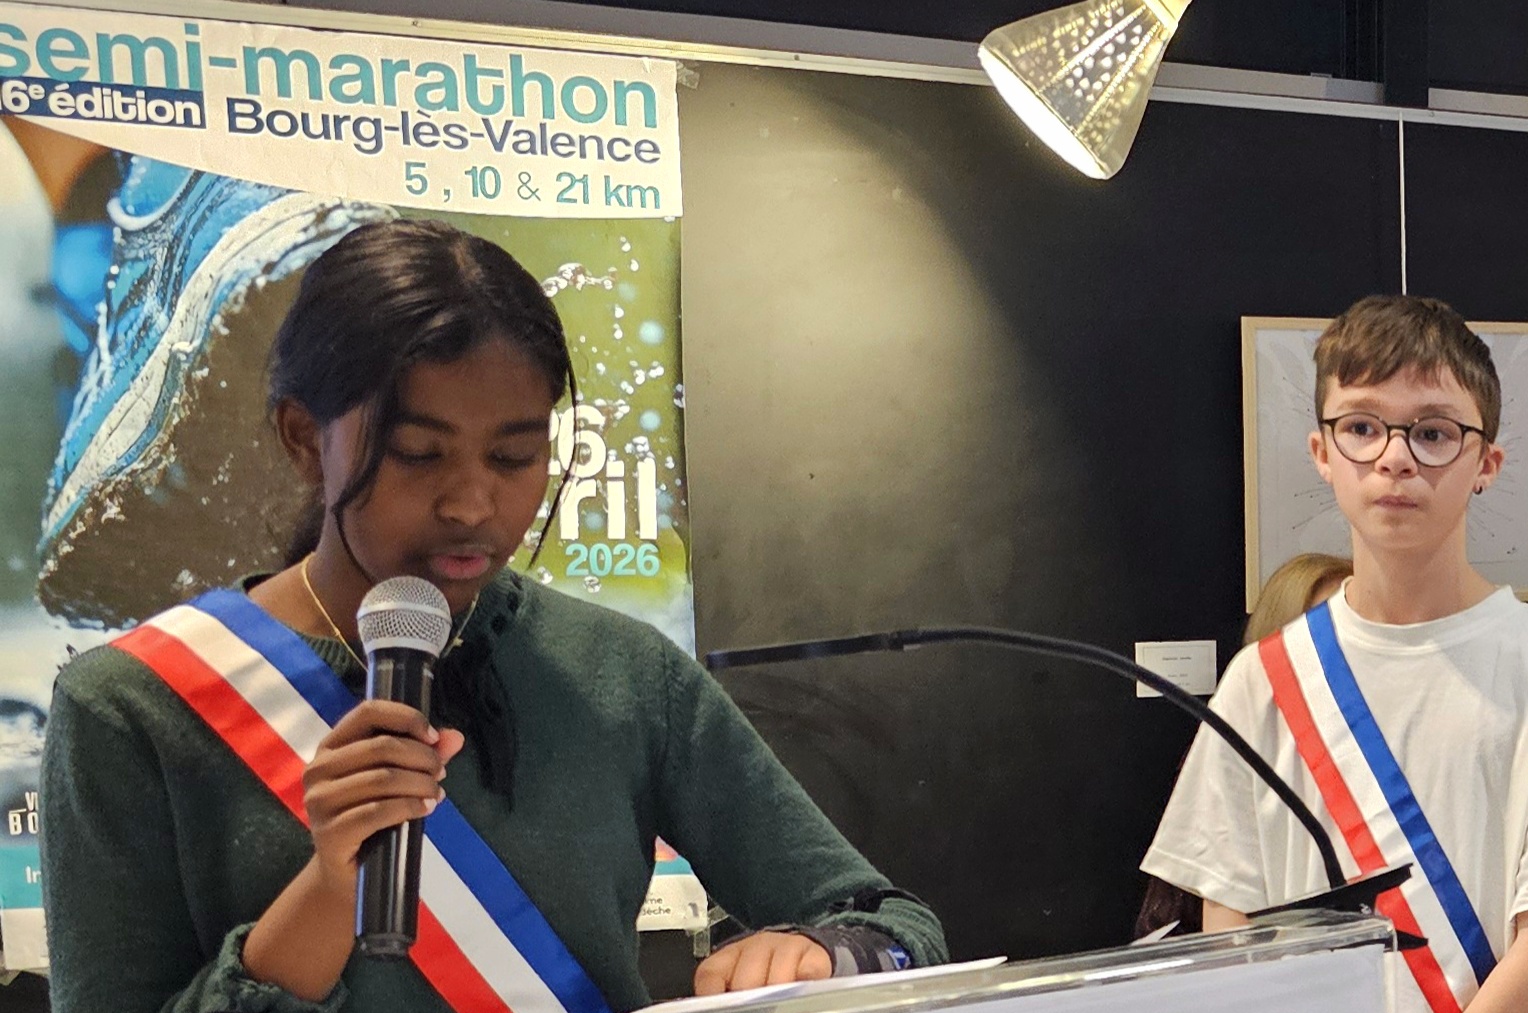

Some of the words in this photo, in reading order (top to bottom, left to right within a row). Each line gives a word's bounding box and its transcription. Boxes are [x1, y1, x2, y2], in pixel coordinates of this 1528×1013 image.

[0, 22, 657, 129] semi-marathon
[0, 80, 45, 113] 6e
[50, 82, 202, 126] édition
[226, 97, 661, 164] Bourg-lès-Valence
[405, 162, 428, 195] 5
[464, 166, 501, 199] 10
[516, 171, 541, 201] &
[556, 172, 590, 205] 21
[604, 175, 661, 209] km
[548, 405, 607, 478] 6
[559, 453, 658, 540] ril
[565, 543, 660, 577] 2026
